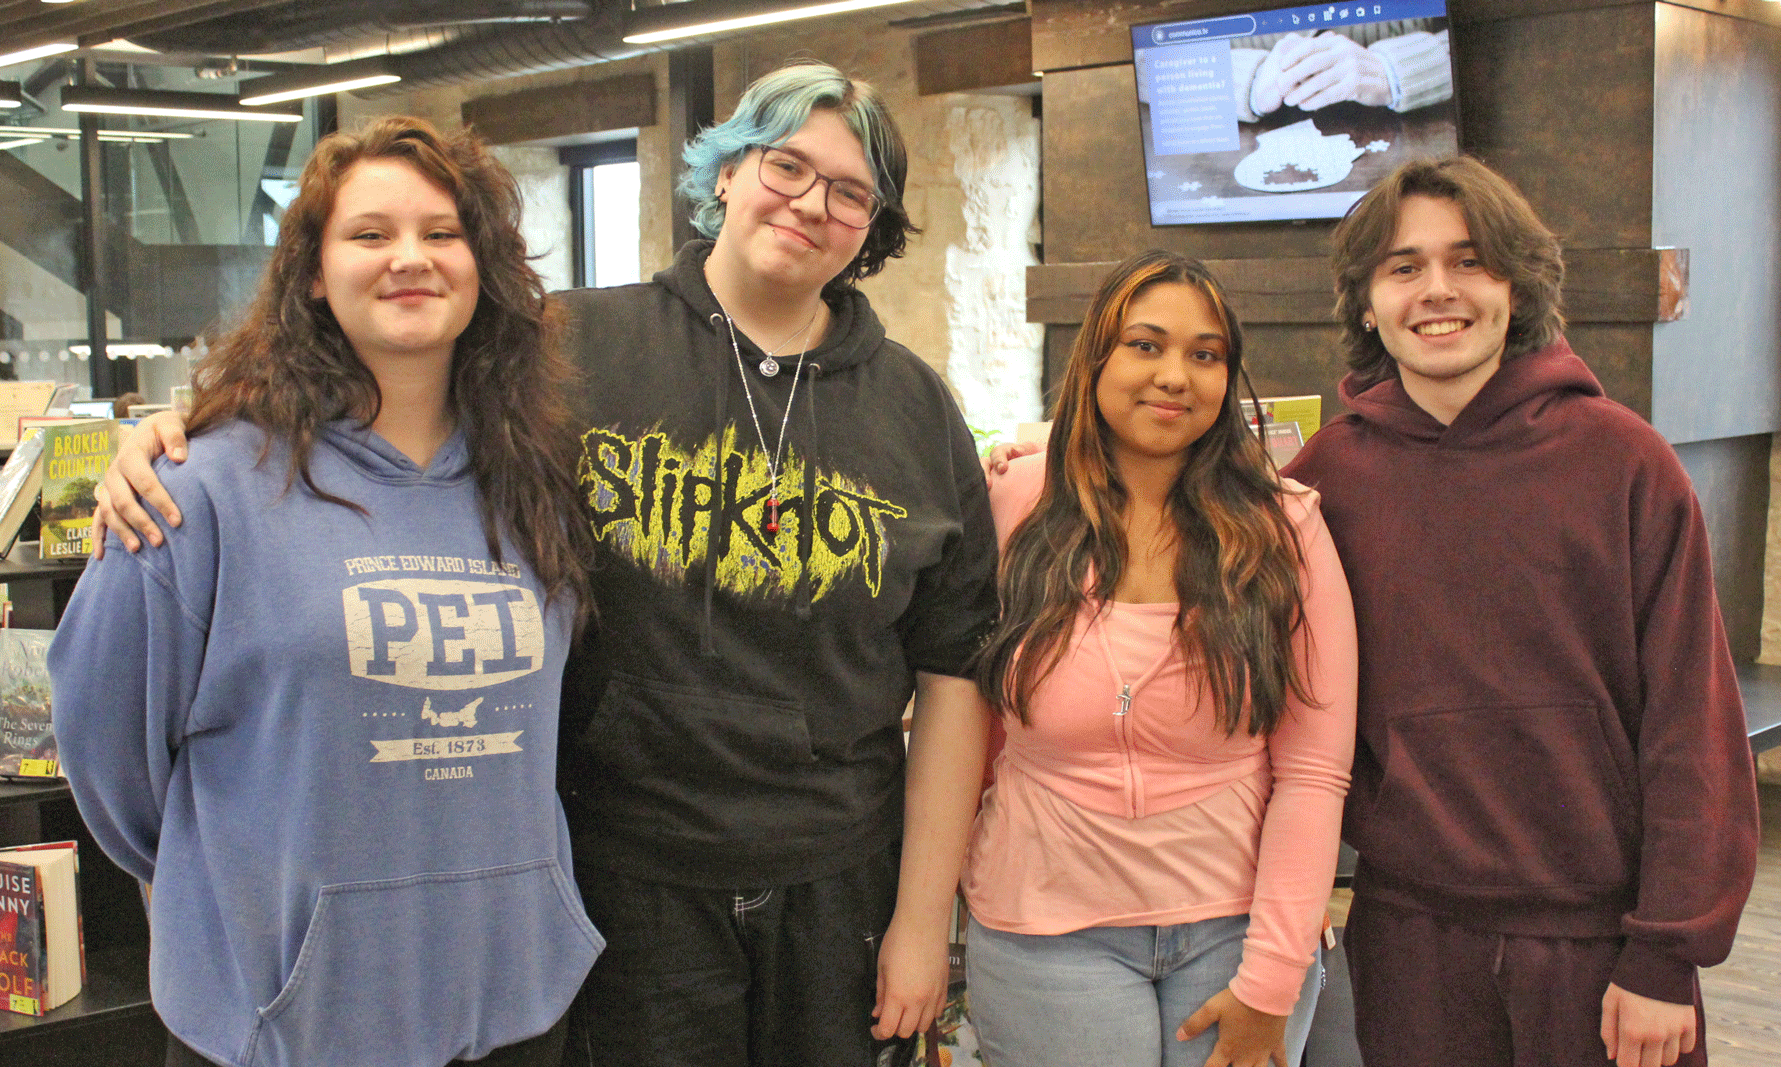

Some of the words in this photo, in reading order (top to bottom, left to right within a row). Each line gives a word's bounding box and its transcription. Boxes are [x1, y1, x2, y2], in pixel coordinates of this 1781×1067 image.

[1188, 69, 1214, 79] living
[54, 430, 109, 457] BROKEN
[49, 454, 111, 480] COUNTRY
[50, 541, 82, 556] LESLIE
[344, 555, 399, 576] PRINCE
[398, 555, 465, 573] EDWARD
[467, 558, 521, 579] ISLAND
[357, 586, 533, 677] PEI
[20, 718, 53, 731] Seven
[3, 731, 38, 749] Rings
[413, 741, 440, 755] Est.
[447, 739, 486, 754] 1873
[424, 765, 474, 780] CANADA
[0, 949, 29, 968] ACK
[0, 972, 34, 997] OLF
